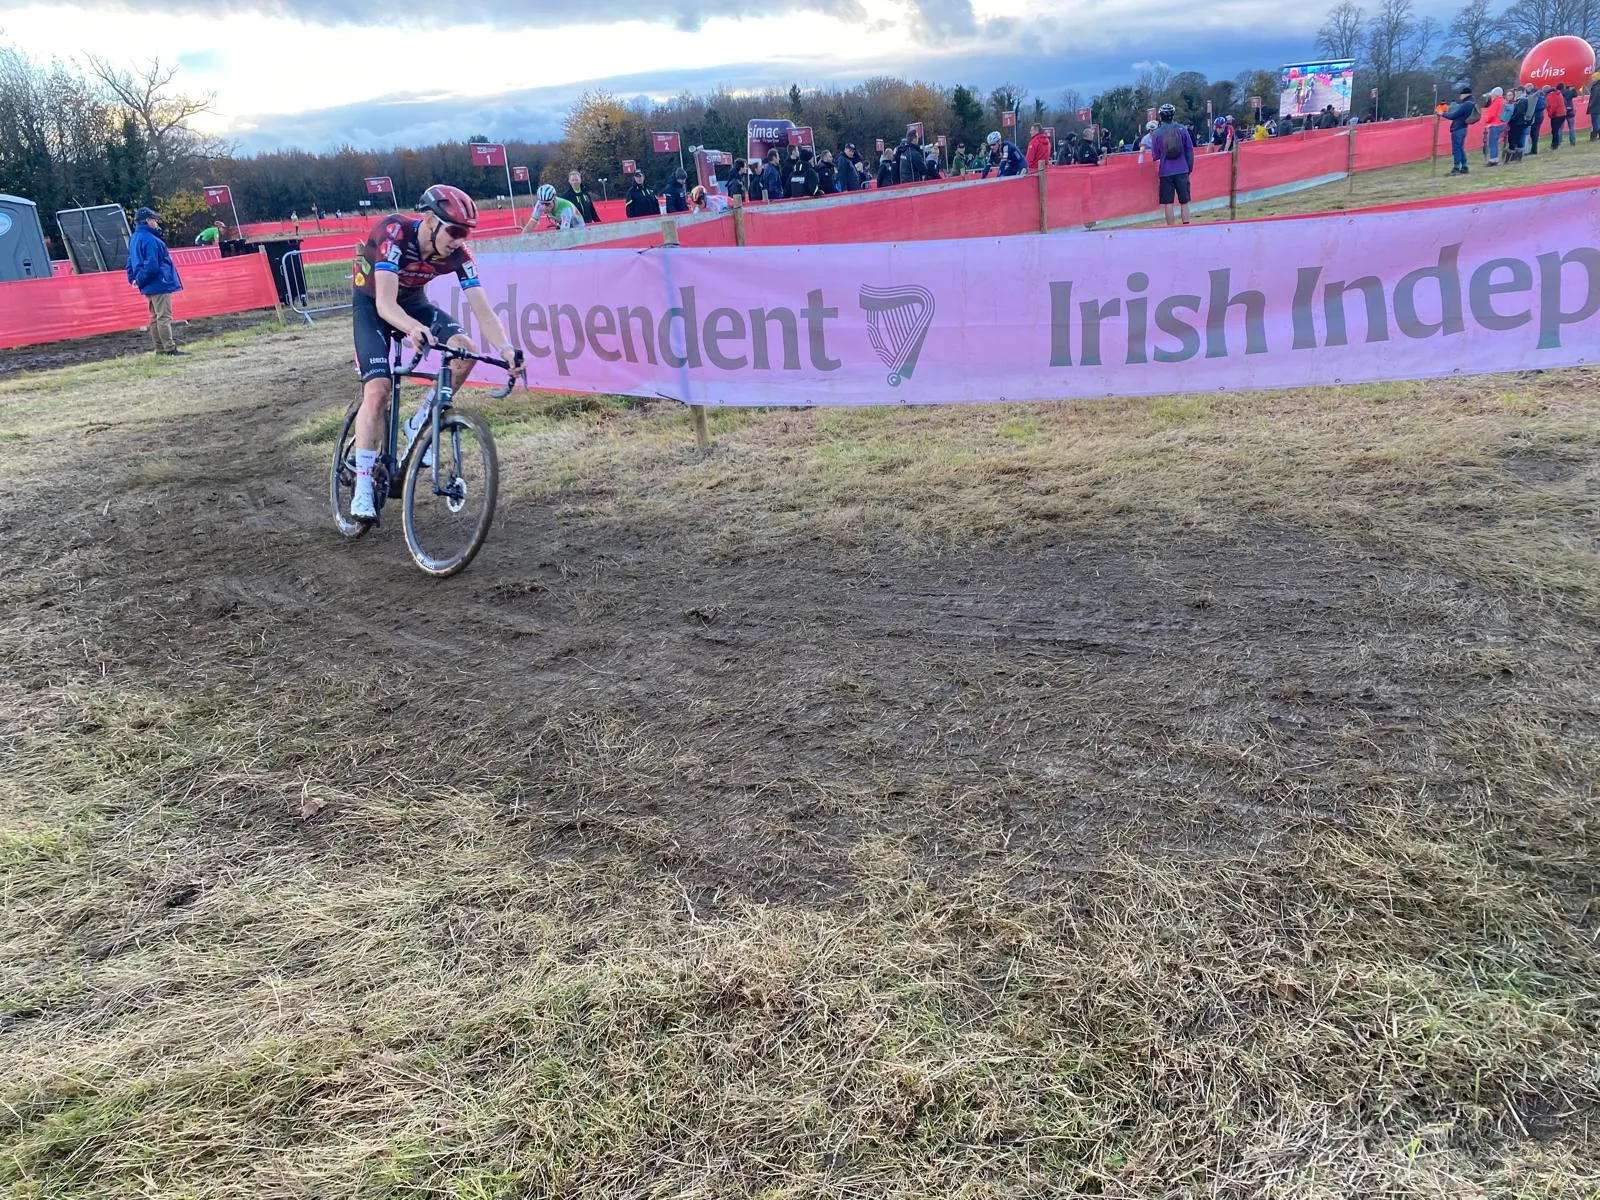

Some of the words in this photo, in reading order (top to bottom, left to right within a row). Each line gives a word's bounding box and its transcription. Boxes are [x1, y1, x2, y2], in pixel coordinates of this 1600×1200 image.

[1530, 59, 1566, 80] ethias
[748, 124, 779, 139] simac
[664, 141, 670, 151] 2
[486, 154, 491, 165] 1
[391, 250, 399, 261] 7
[466, 266, 474, 277] 7
[1049, 268, 1268, 367] Irish
[1291, 242, 1600, 350] Indep
